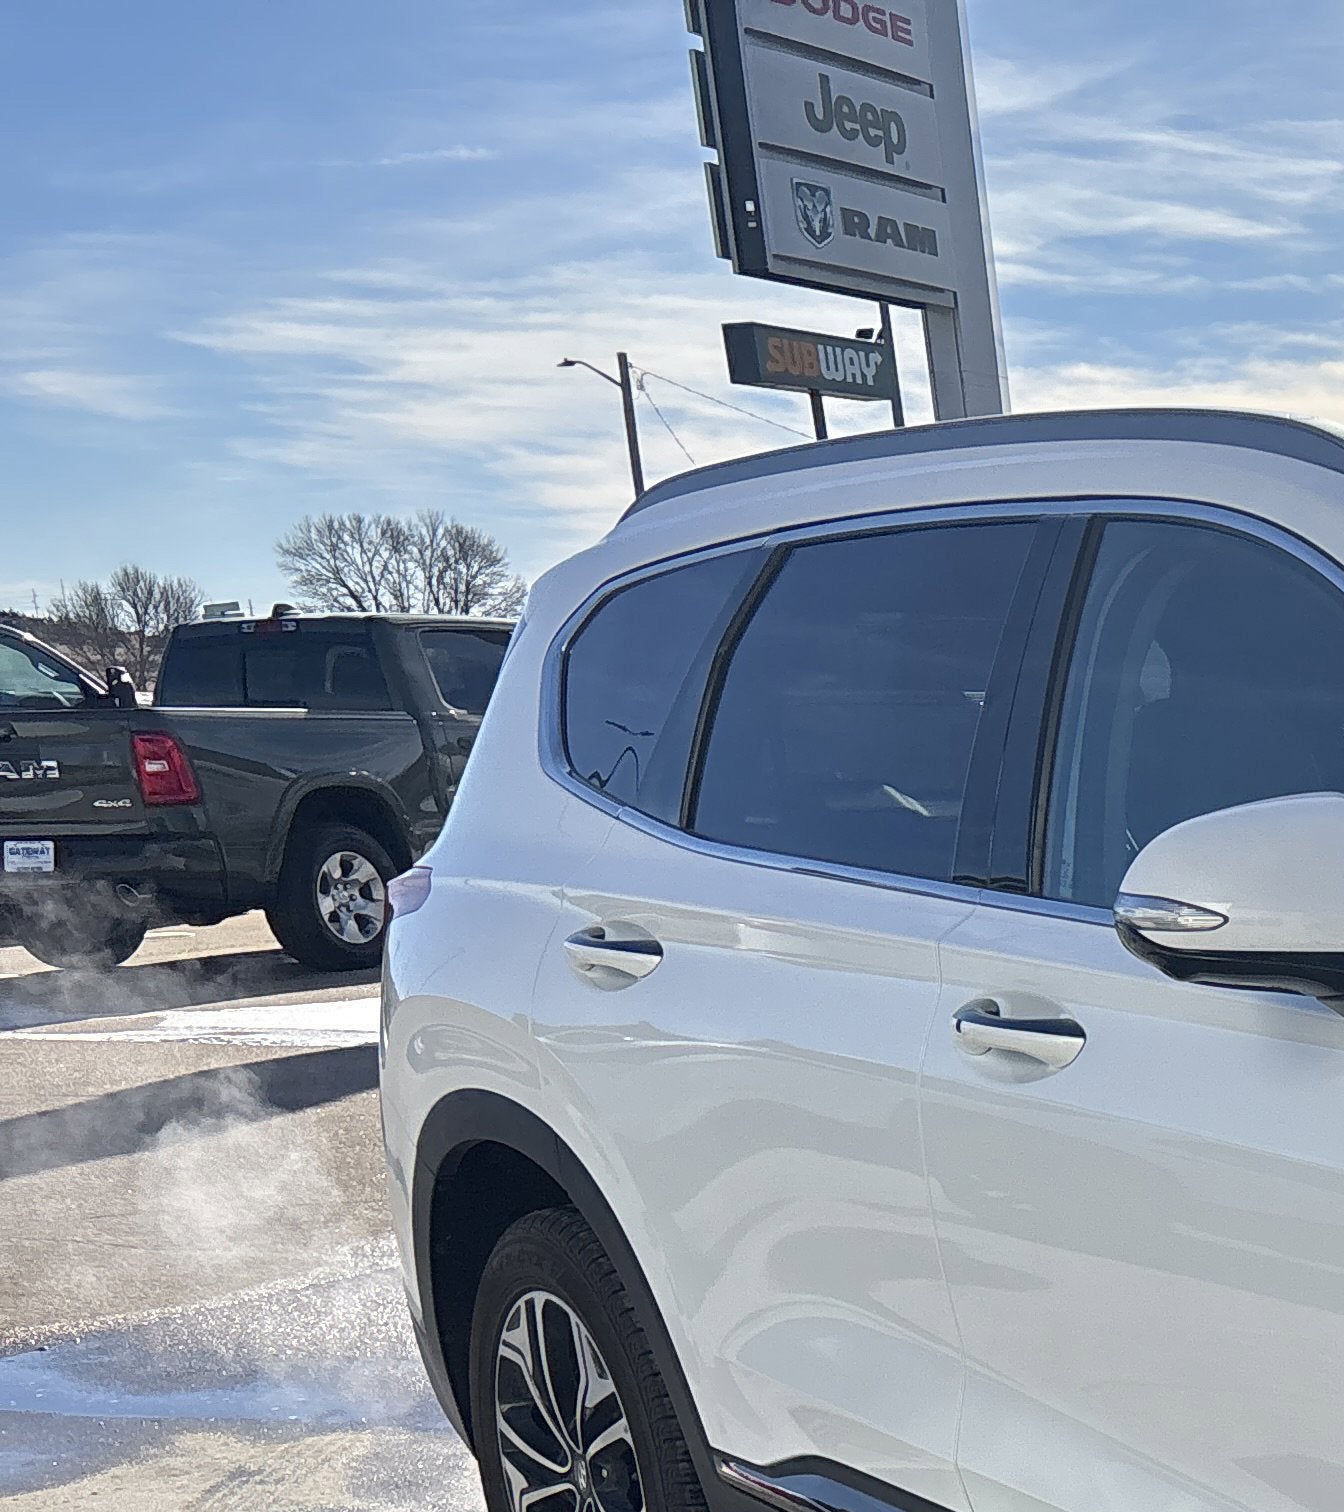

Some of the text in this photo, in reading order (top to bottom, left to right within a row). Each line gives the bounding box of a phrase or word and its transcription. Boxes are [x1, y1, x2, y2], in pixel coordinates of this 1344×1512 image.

[770, 0, 914, 47] DGE
[804, 72, 907, 165] Jeep
[839, 207, 939, 257] RAM
[766, 337, 882, 386] SUBWAY
[0, 760, 60, 779] AM
